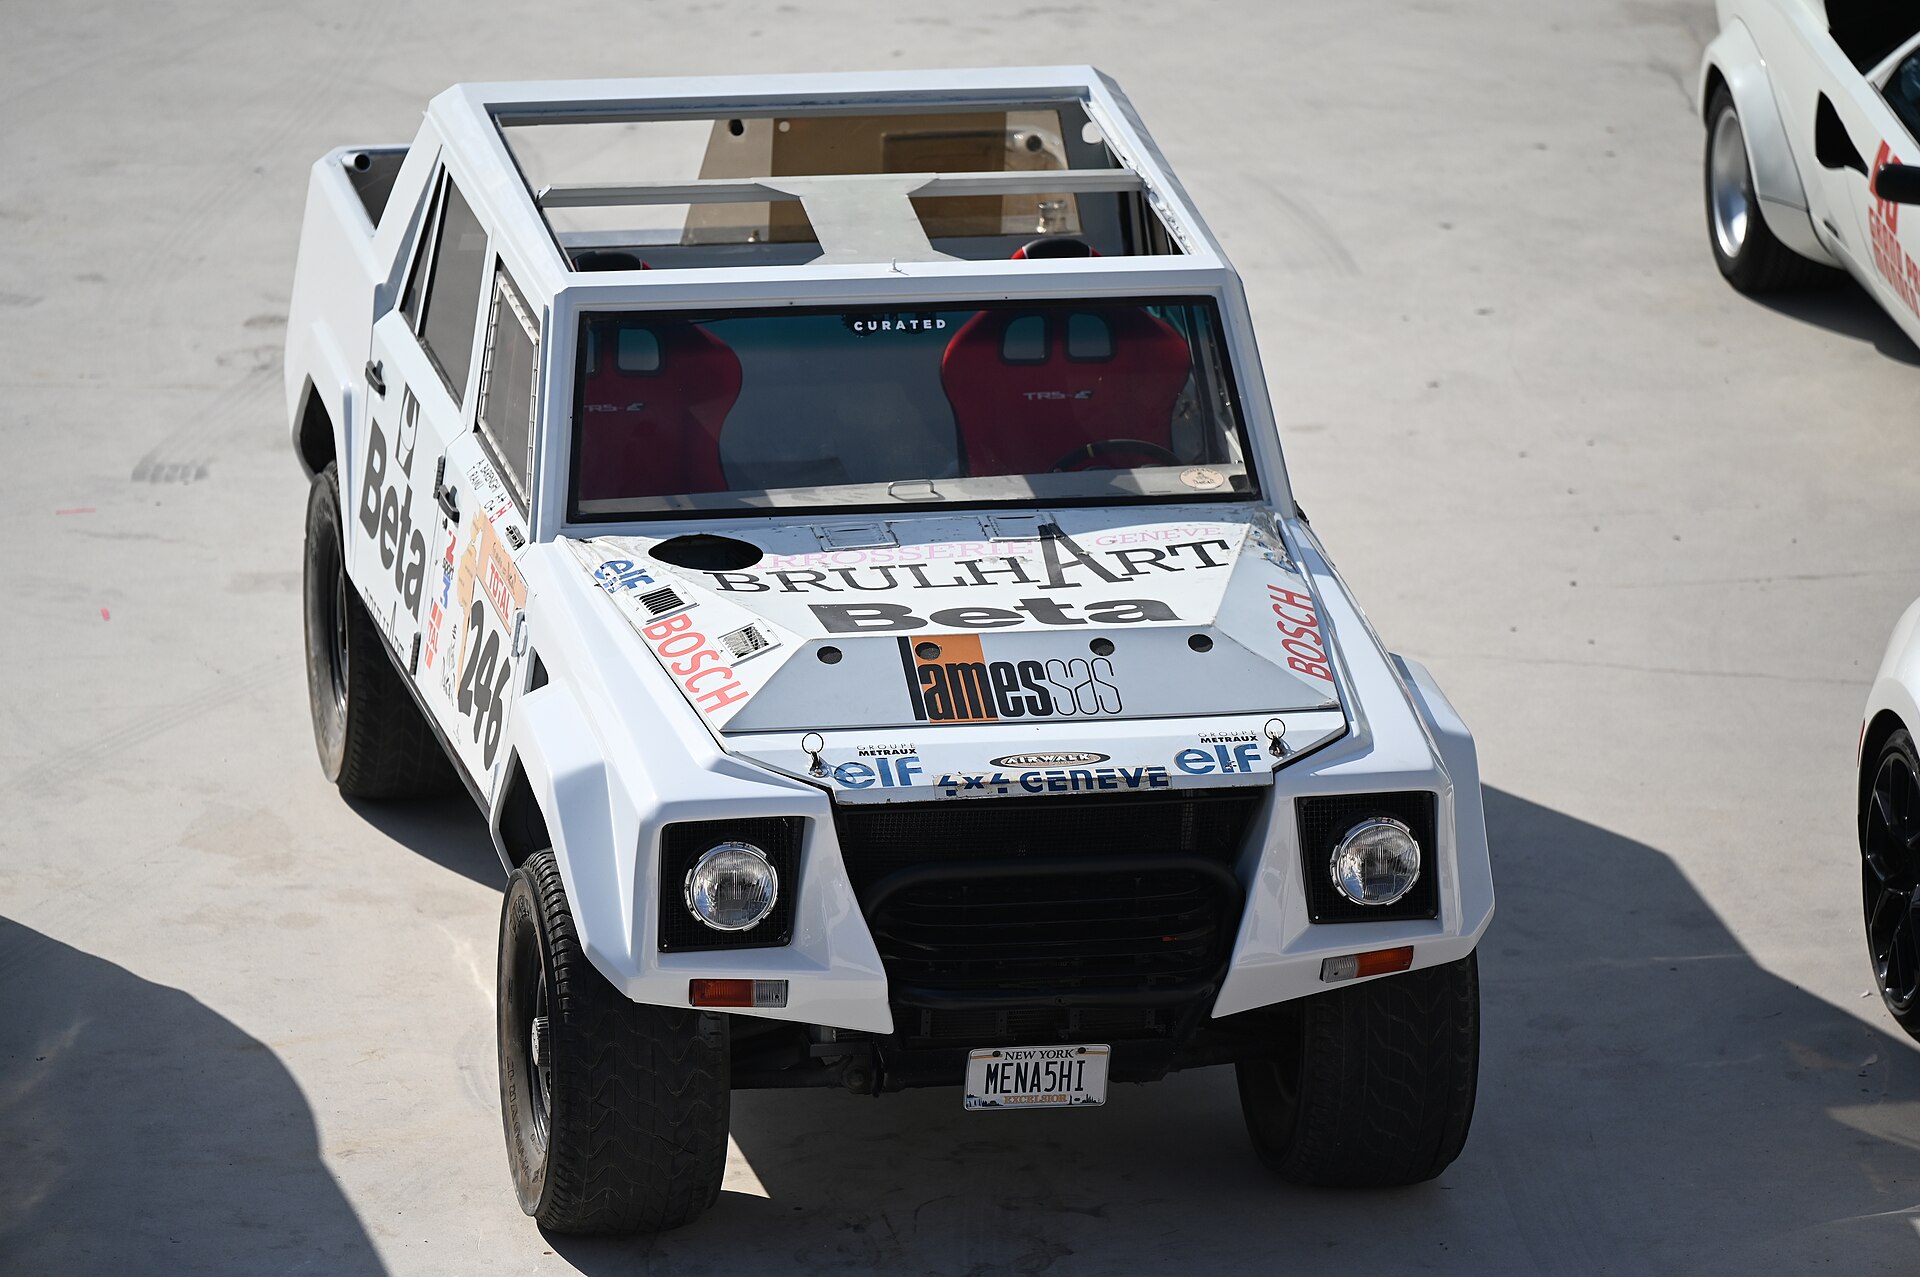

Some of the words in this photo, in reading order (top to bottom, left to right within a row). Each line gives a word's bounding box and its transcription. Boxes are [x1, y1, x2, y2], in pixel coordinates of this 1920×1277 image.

[853, 319, 946, 331] CURATED
[359, 417, 427, 623] Beta
[703, 524, 1230, 594] BRULHART
[489, 564, 510, 621] TOTAL
[594, 560, 655, 593] elf
[808, 597, 1183, 634] Beta
[1266, 584, 1333, 682] BOSCH
[642, 614, 749, 714] BOSCH
[458, 600, 510, 771] 246
[859, 749, 917, 757] METRAUX
[1200, 736, 1257, 744] METRAUX
[834, 757, 923, 789] elf
[1004, 753, 1090, 765] AIRWALK
[1174, 744, 1262, 775] elf
[1019, 766, 1169, 794] GENEVE
[1004, 1052, 1035, 1061] NEW
[1040, 1049, 1075, 1060] YORK
[1004, 1094, 1068, 1105] EXCELSIOR
